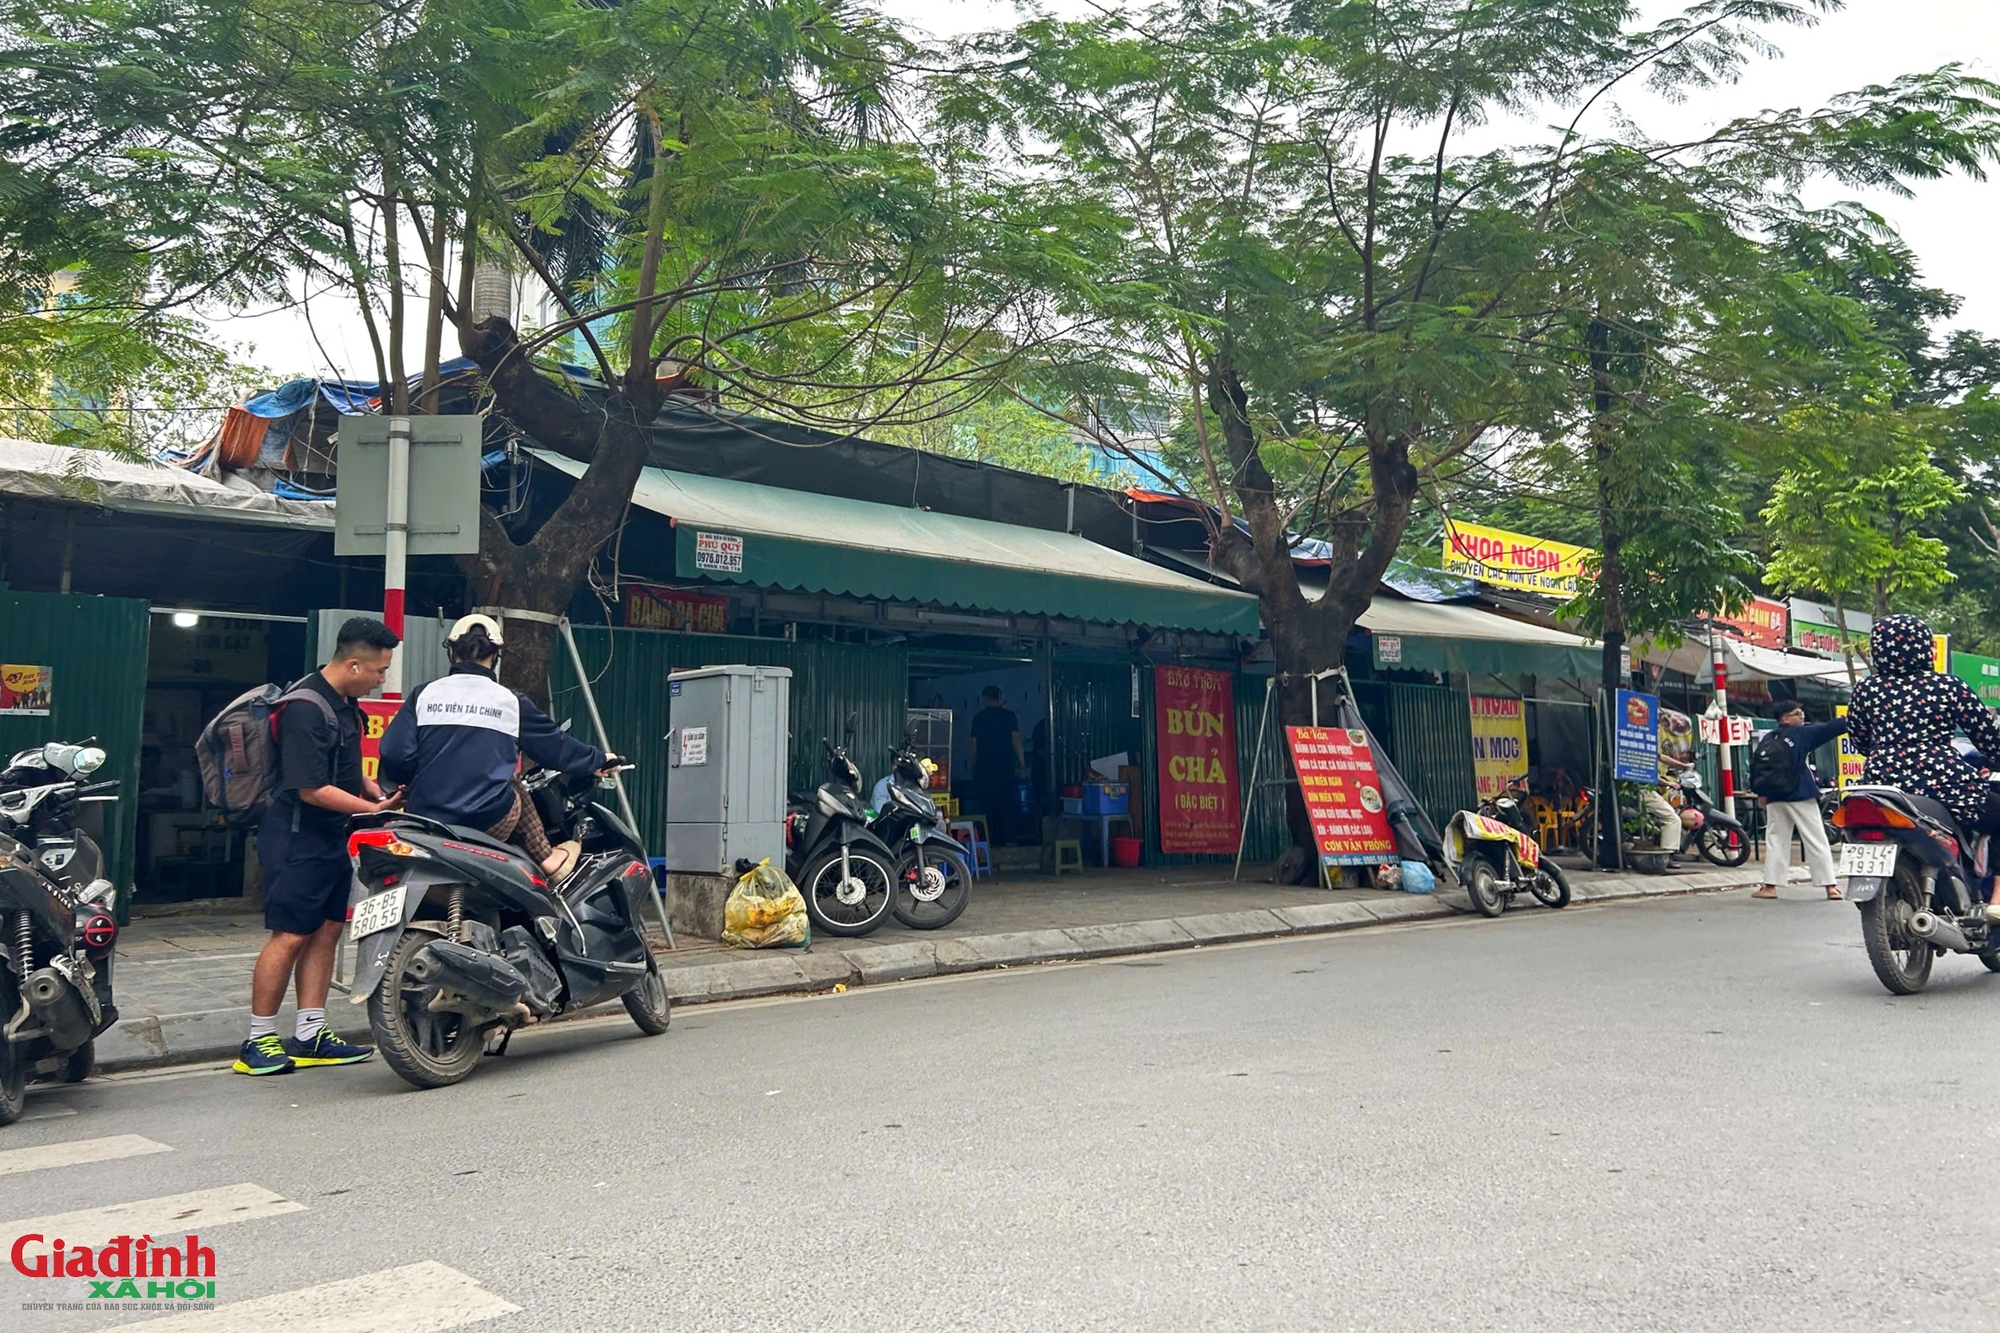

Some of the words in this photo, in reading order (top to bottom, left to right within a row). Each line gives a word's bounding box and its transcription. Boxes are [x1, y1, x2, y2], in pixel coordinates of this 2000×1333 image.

[1451, 532, 1503, 562] KHOA
[1511, 544, 1559, 573] NGAN
[427, 703, 443, 715] HỌC
[445, 703, 462, 715] VIỆN
[465, 703, 478, 714] TÀI
[479, 704, 503, 719] CHÍNH
[1167, 703, 1224, 738] BÚN
[1490, 737, 1520, 764] MỌC
[1169, 748, 1227, 784] CHẢ
[1324, 840, 1341, 851] CƠM
[1363, 838, 1392, 851] PHÒNG
[1848, 861, 1885, 874] 1931
[360, 891, 398, 917] 36-B5
[353, 907, 398, 937] 580.55
